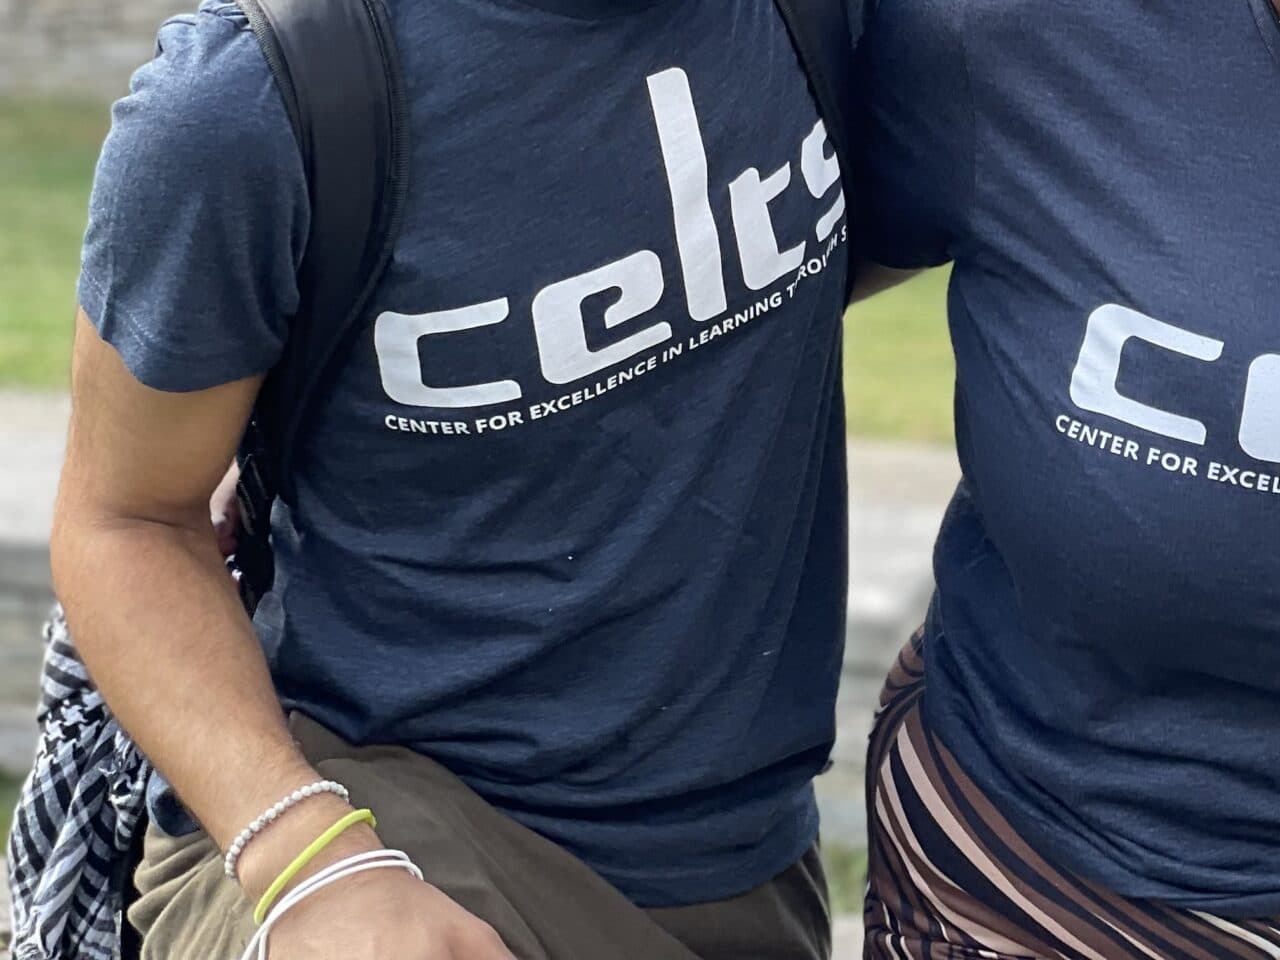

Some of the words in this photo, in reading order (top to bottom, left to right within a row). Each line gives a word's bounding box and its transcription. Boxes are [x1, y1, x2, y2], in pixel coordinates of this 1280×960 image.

[374, 66, 847, 408] celts
[384, 415, 471, 435] CENTER
[475, 412, 524, 434] FOR
[529, 356, 657, 421] EXCELLENCE
[662, 342, 683, 363] IN
[689, 291, 782, 351] LEARNING
[1055, 414, 1140, 461] CENTER
[1146, 447, 1198, 477] FOR
